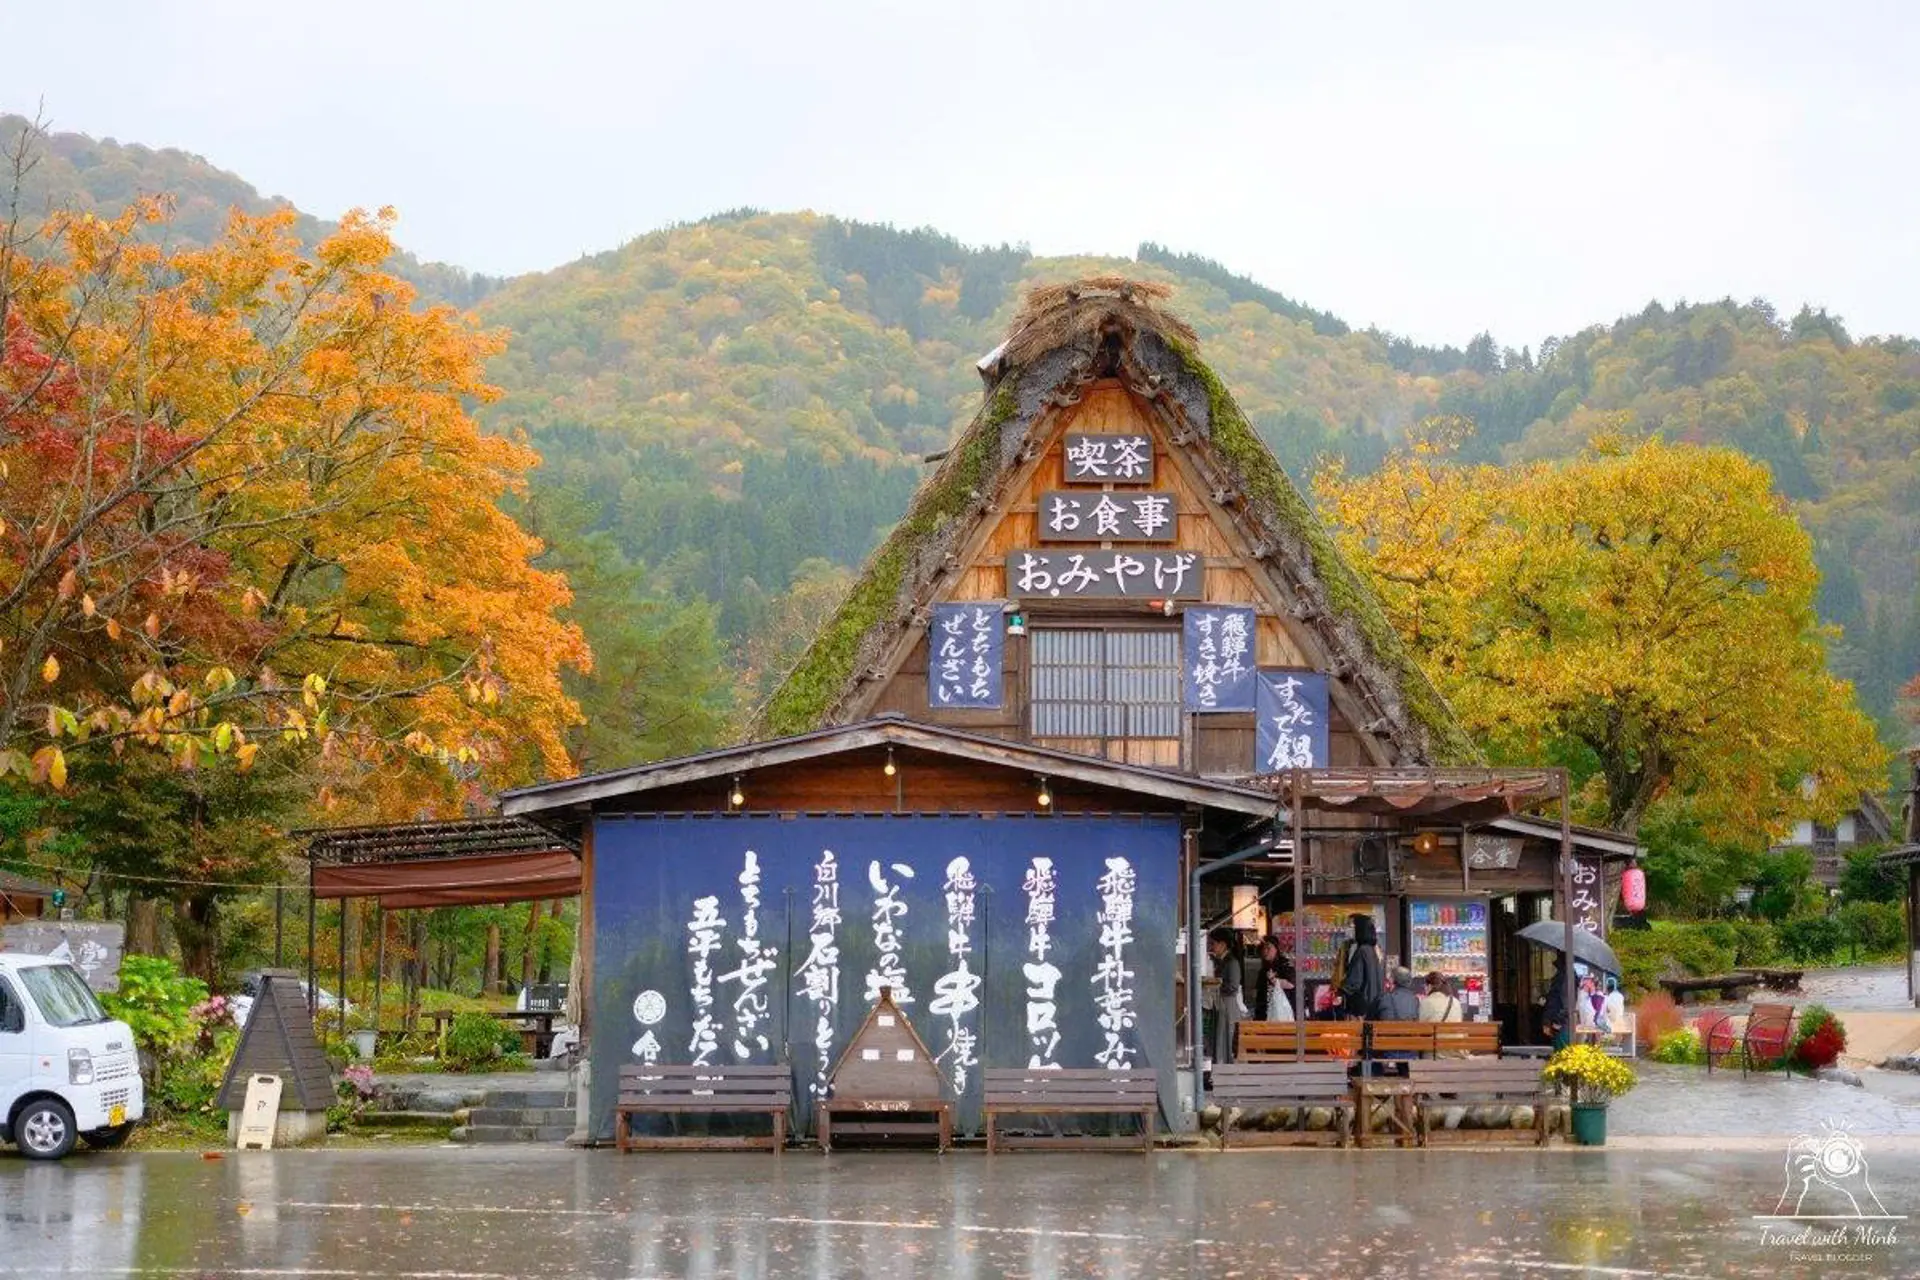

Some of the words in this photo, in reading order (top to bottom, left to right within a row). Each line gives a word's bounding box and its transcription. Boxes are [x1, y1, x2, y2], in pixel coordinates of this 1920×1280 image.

[1067, 437, 1150, 478] 喫茶
[1049, 494, 1170, 537] お食事
[1017, 552, 1196, 596] おみやげ
[938, 611, 968, 703] ぜんざい
[970, 608, 992, 699] とちもち
[1192, 613, 1222, 707] すき焼き
[1220, 613, 1248, 683] 飛騨牛
[863, 860, 916, 1014] いわなの塩
[929, 855, 982, 1095] 飛騨牛串焼き
